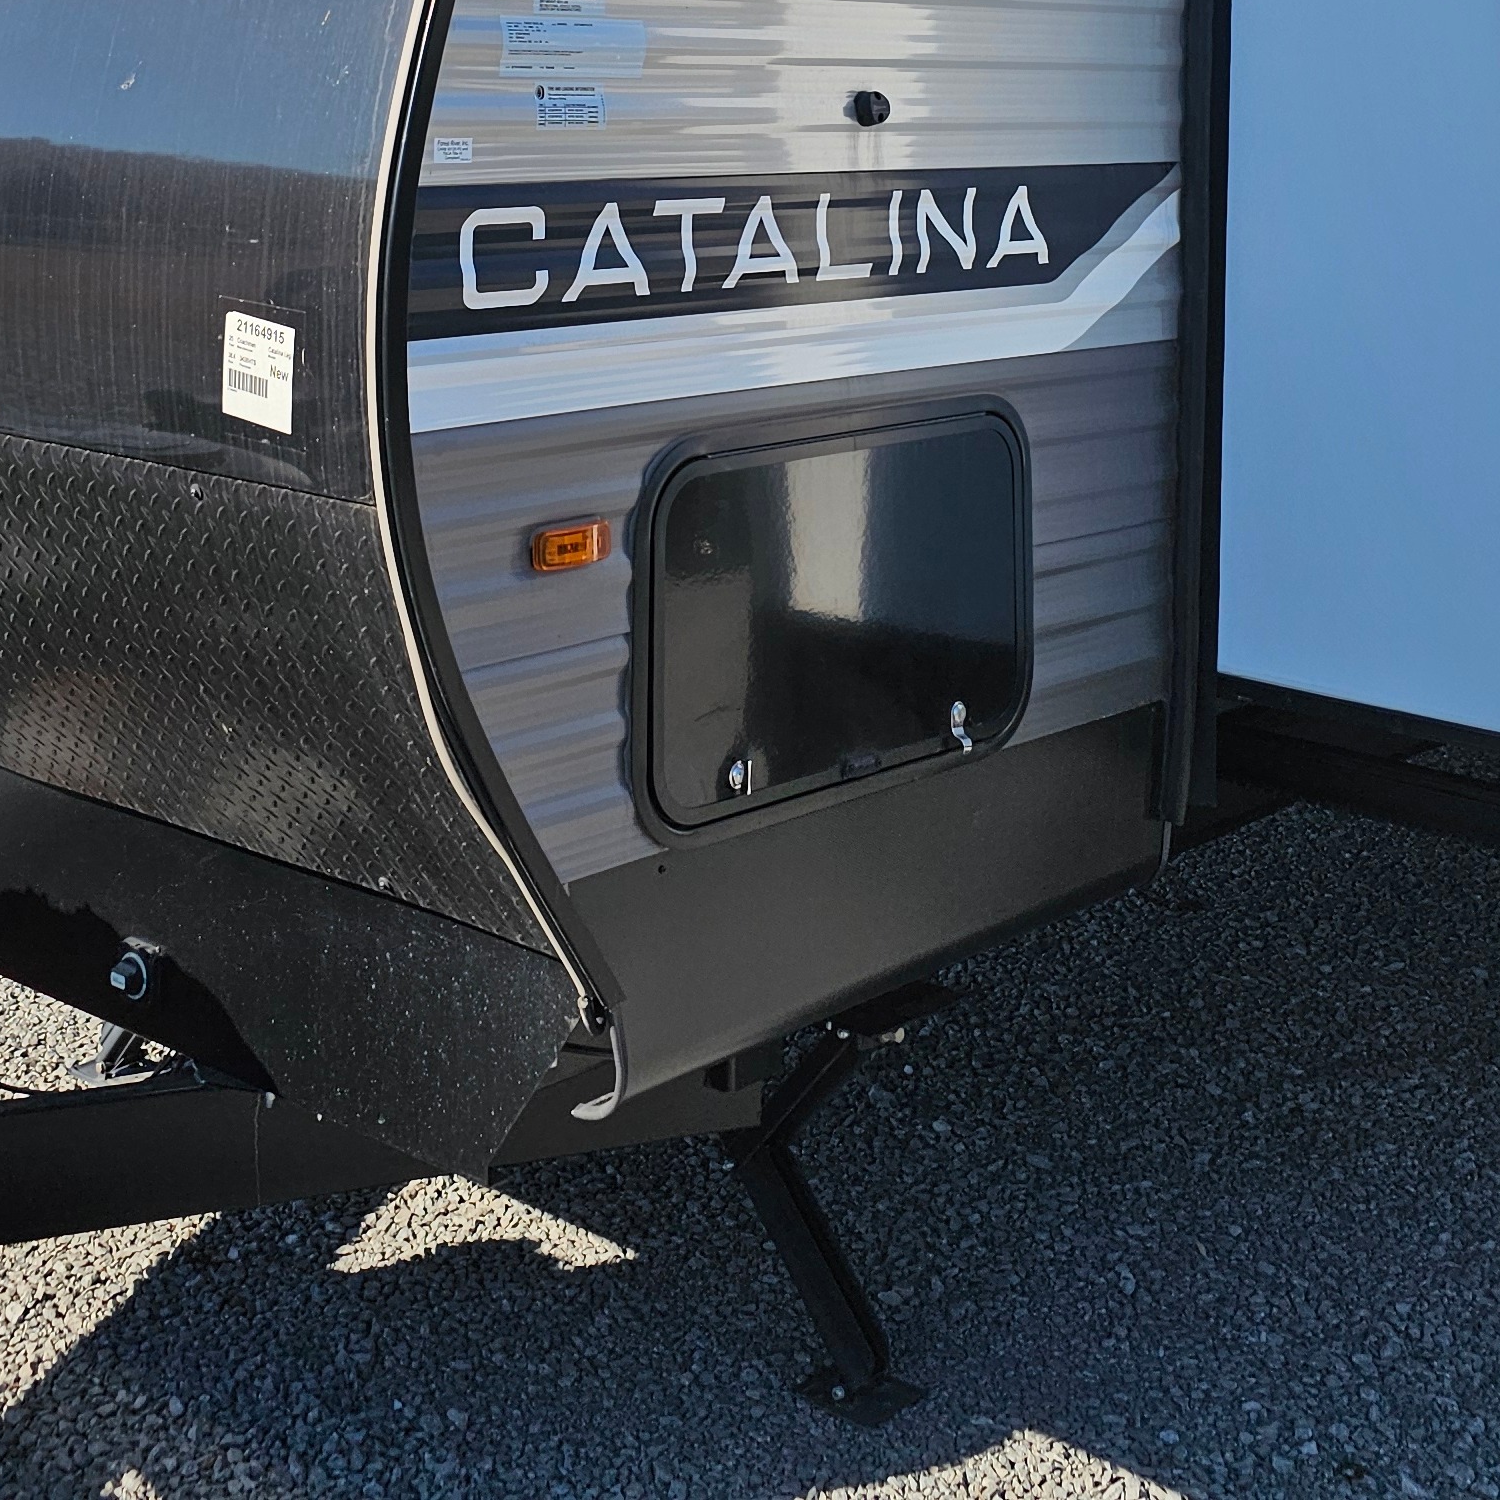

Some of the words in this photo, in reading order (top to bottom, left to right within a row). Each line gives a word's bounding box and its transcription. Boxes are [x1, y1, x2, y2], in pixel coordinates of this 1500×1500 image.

[459, 185, 1050, 310] CATALINA
[237, 319, 284, 344] 21164915
[269, 364, 289, 382] New
